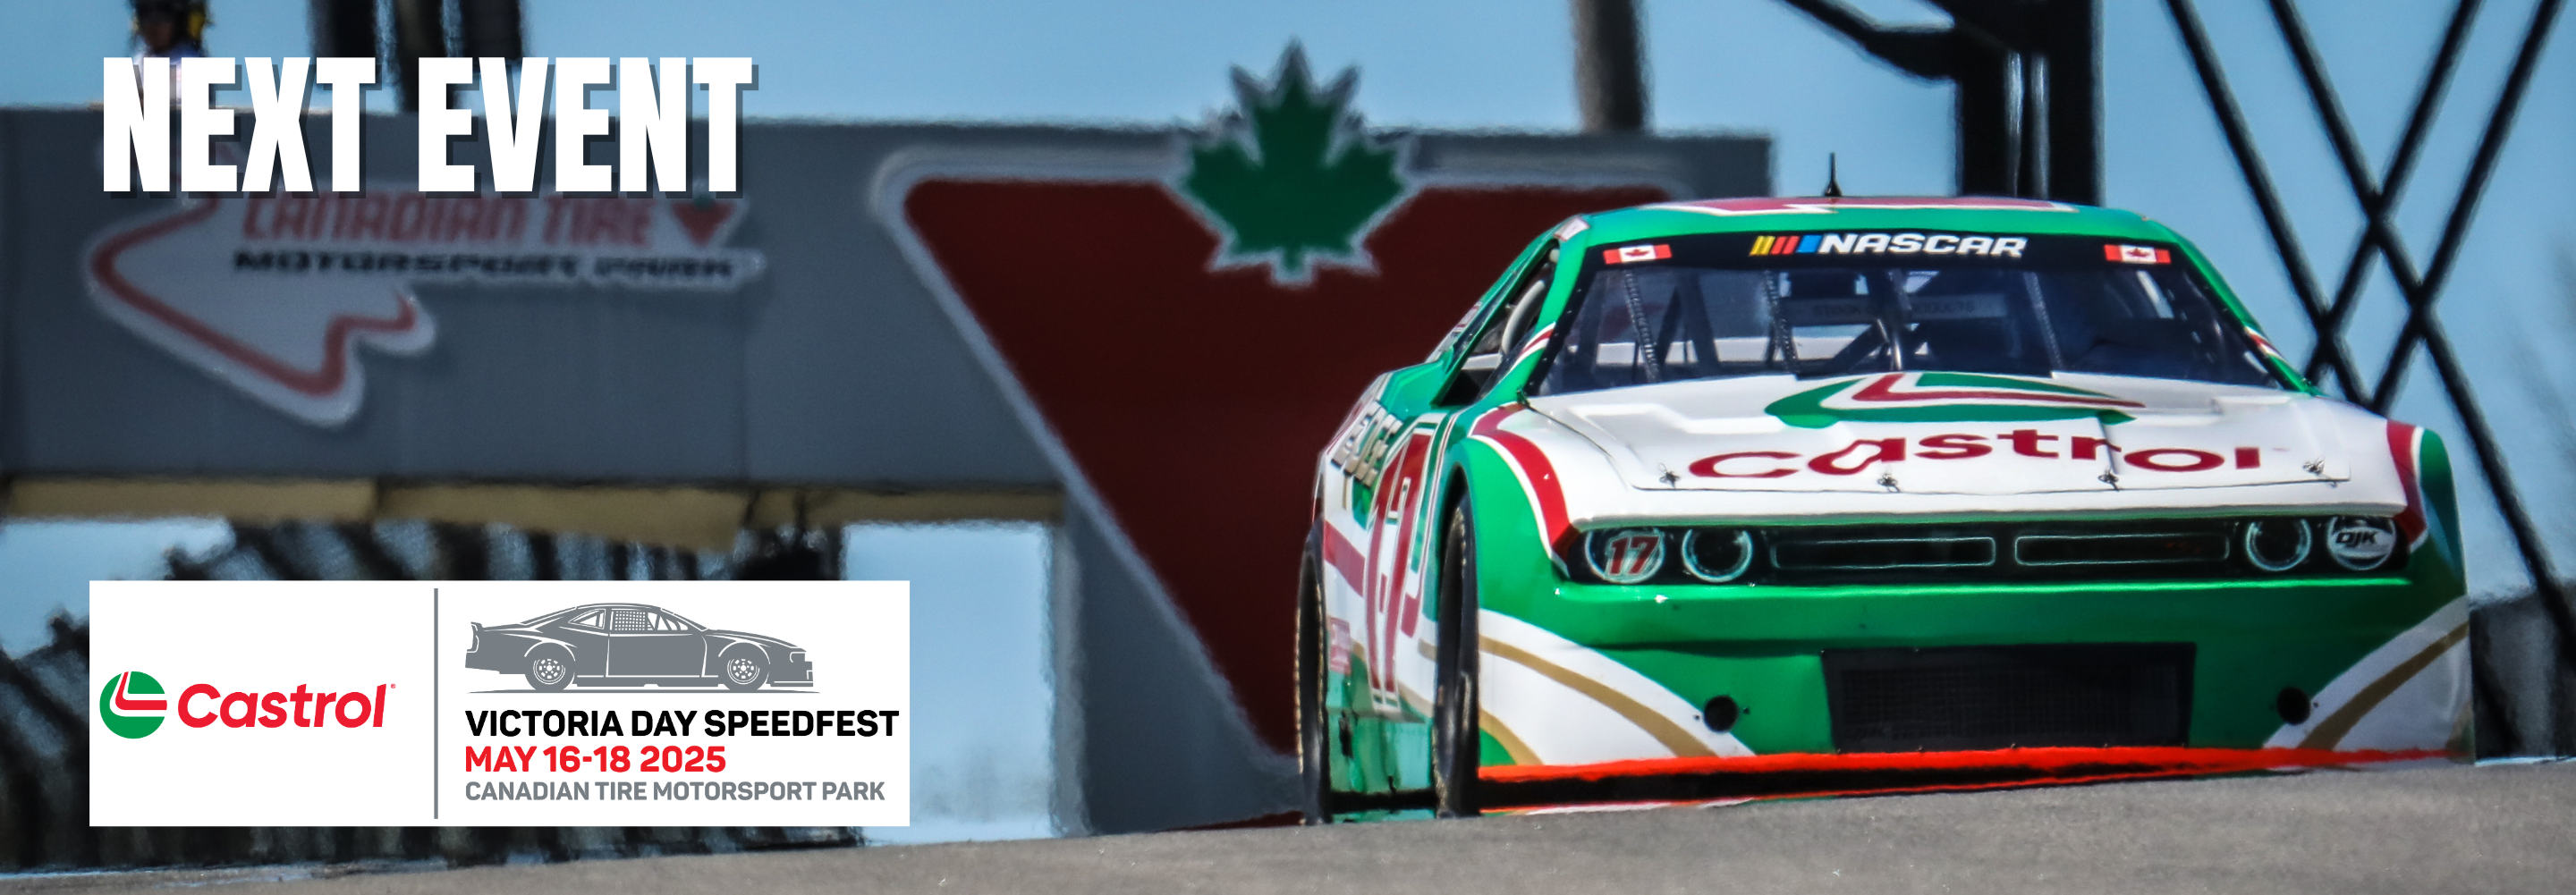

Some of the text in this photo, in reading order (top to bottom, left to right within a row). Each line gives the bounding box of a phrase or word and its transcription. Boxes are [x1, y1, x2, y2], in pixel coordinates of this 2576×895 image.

[243, 191, 655, 247] CANADIAN TIRE
[1818, 233, 2029, 258] NASCAR
[233, 250, 733, 278] MOTORSPORT PARK
[1609, 535, 1660, 575] 17
